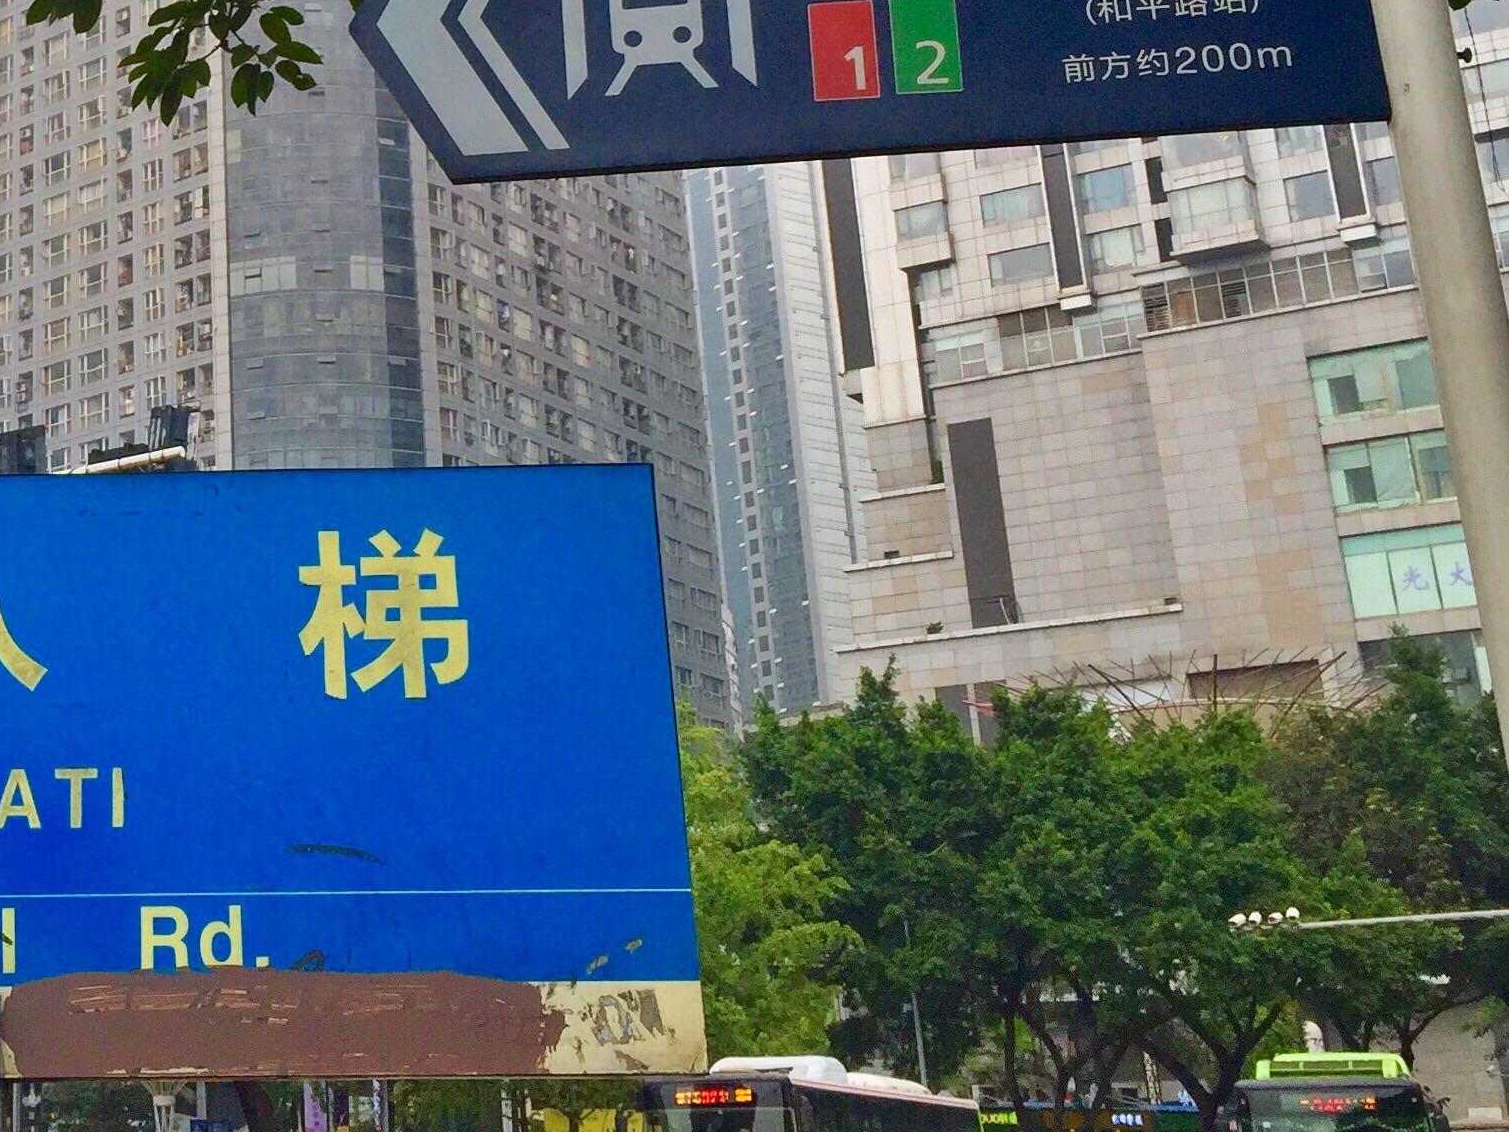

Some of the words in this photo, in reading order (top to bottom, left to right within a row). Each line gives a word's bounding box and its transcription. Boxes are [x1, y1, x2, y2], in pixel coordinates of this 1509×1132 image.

[843, 45, 867, 91] 1
[915, 39, 951, 85] 2
[1061, 42, 1293, 84] 前方约200m
[139, 904, 270, 969] Rd.
